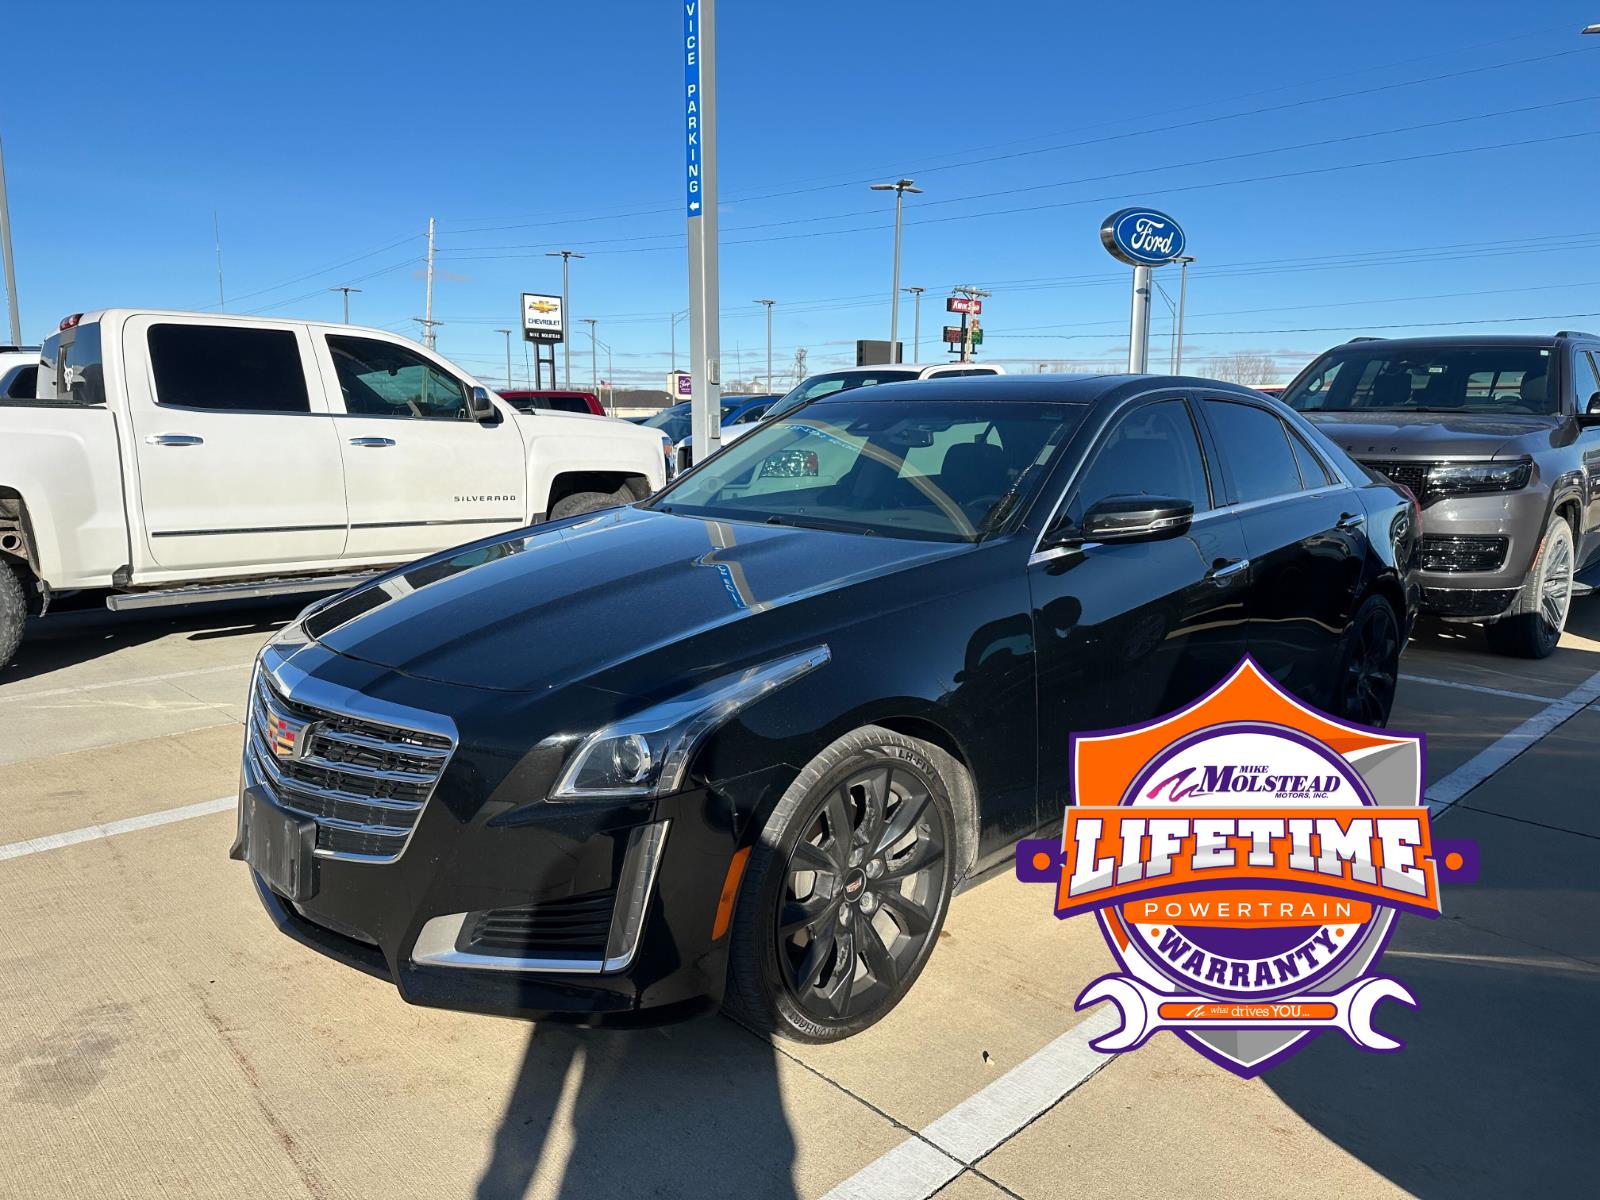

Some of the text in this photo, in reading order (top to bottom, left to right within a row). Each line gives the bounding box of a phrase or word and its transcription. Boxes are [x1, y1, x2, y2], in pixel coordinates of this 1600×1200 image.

[686, 2, 698, 193] VICE PARKING
[1131, 218, 1174, 254] Ford
[528, 317, 560, 326] CHEVROLET
